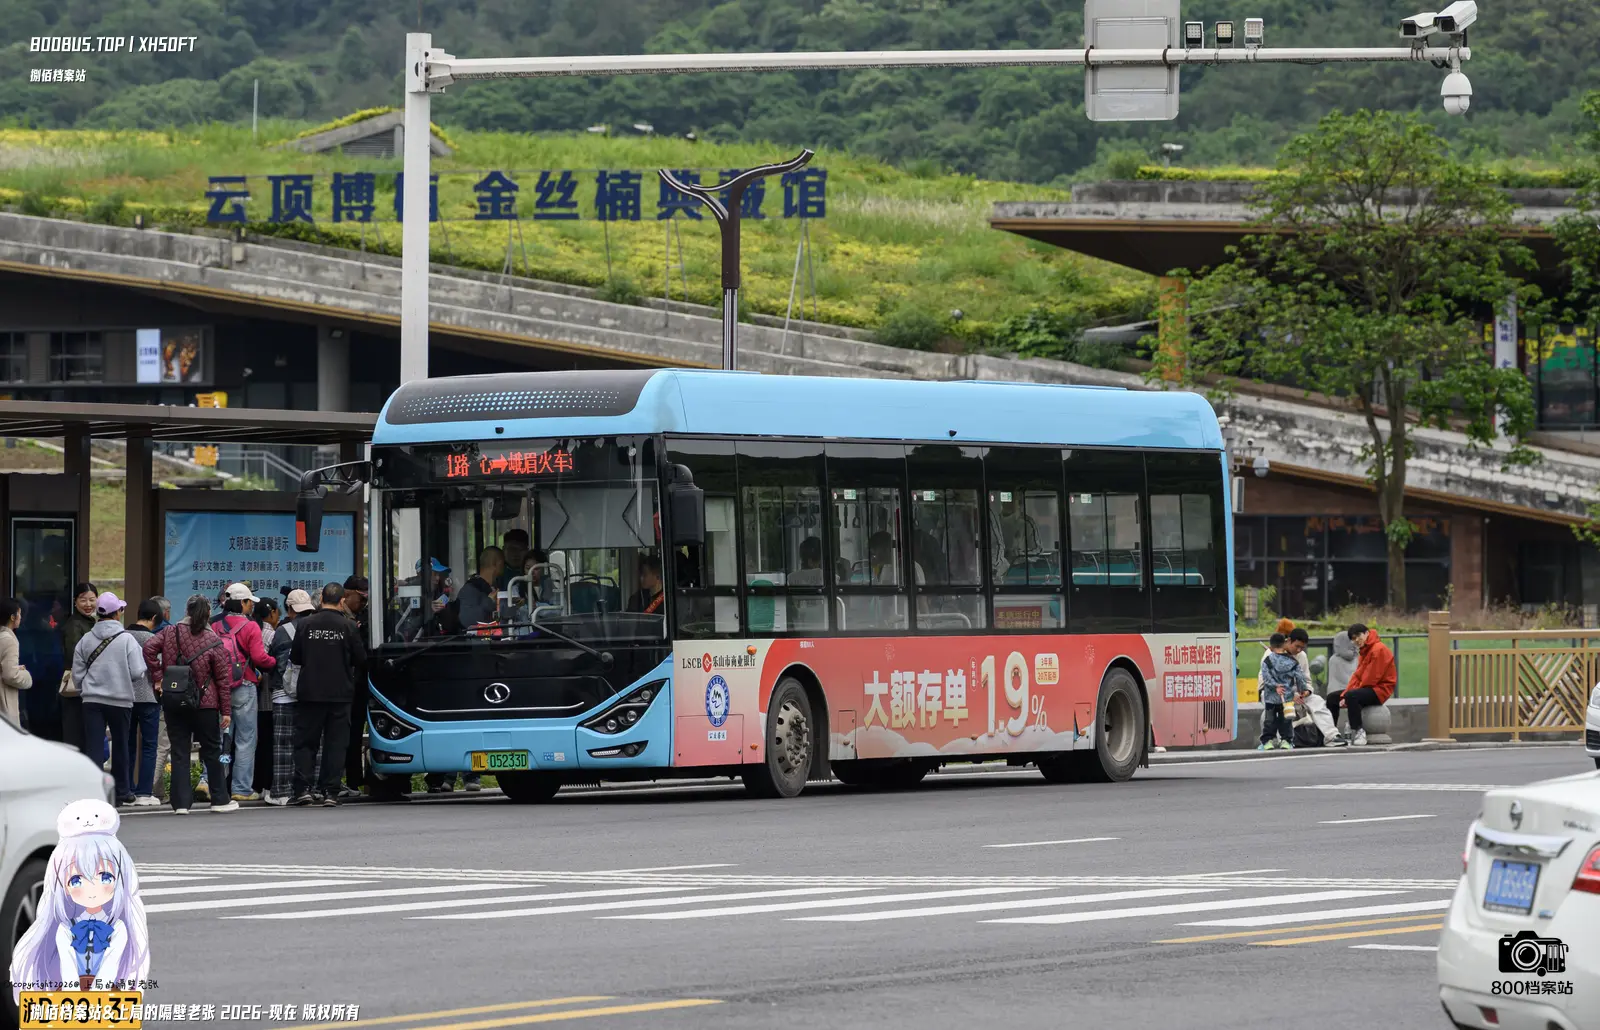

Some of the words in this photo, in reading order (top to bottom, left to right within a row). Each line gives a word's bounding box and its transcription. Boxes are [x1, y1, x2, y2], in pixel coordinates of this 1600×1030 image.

[447, 454, 470, 477] 1路
[508, 450, 573, 475] 峨眉火车
[228, 536, 289, 551] 文明旅游温馨提示
[682, 658, 702, 669] LSCB
[713, 654, 756, 668] 乐山市商业银行
[1164, 645, 1221, 664] 乐山市商业银行
[1165, 675, 1221, 698] 国有控股银行
[864, 669, 969, 730] 大额存单
